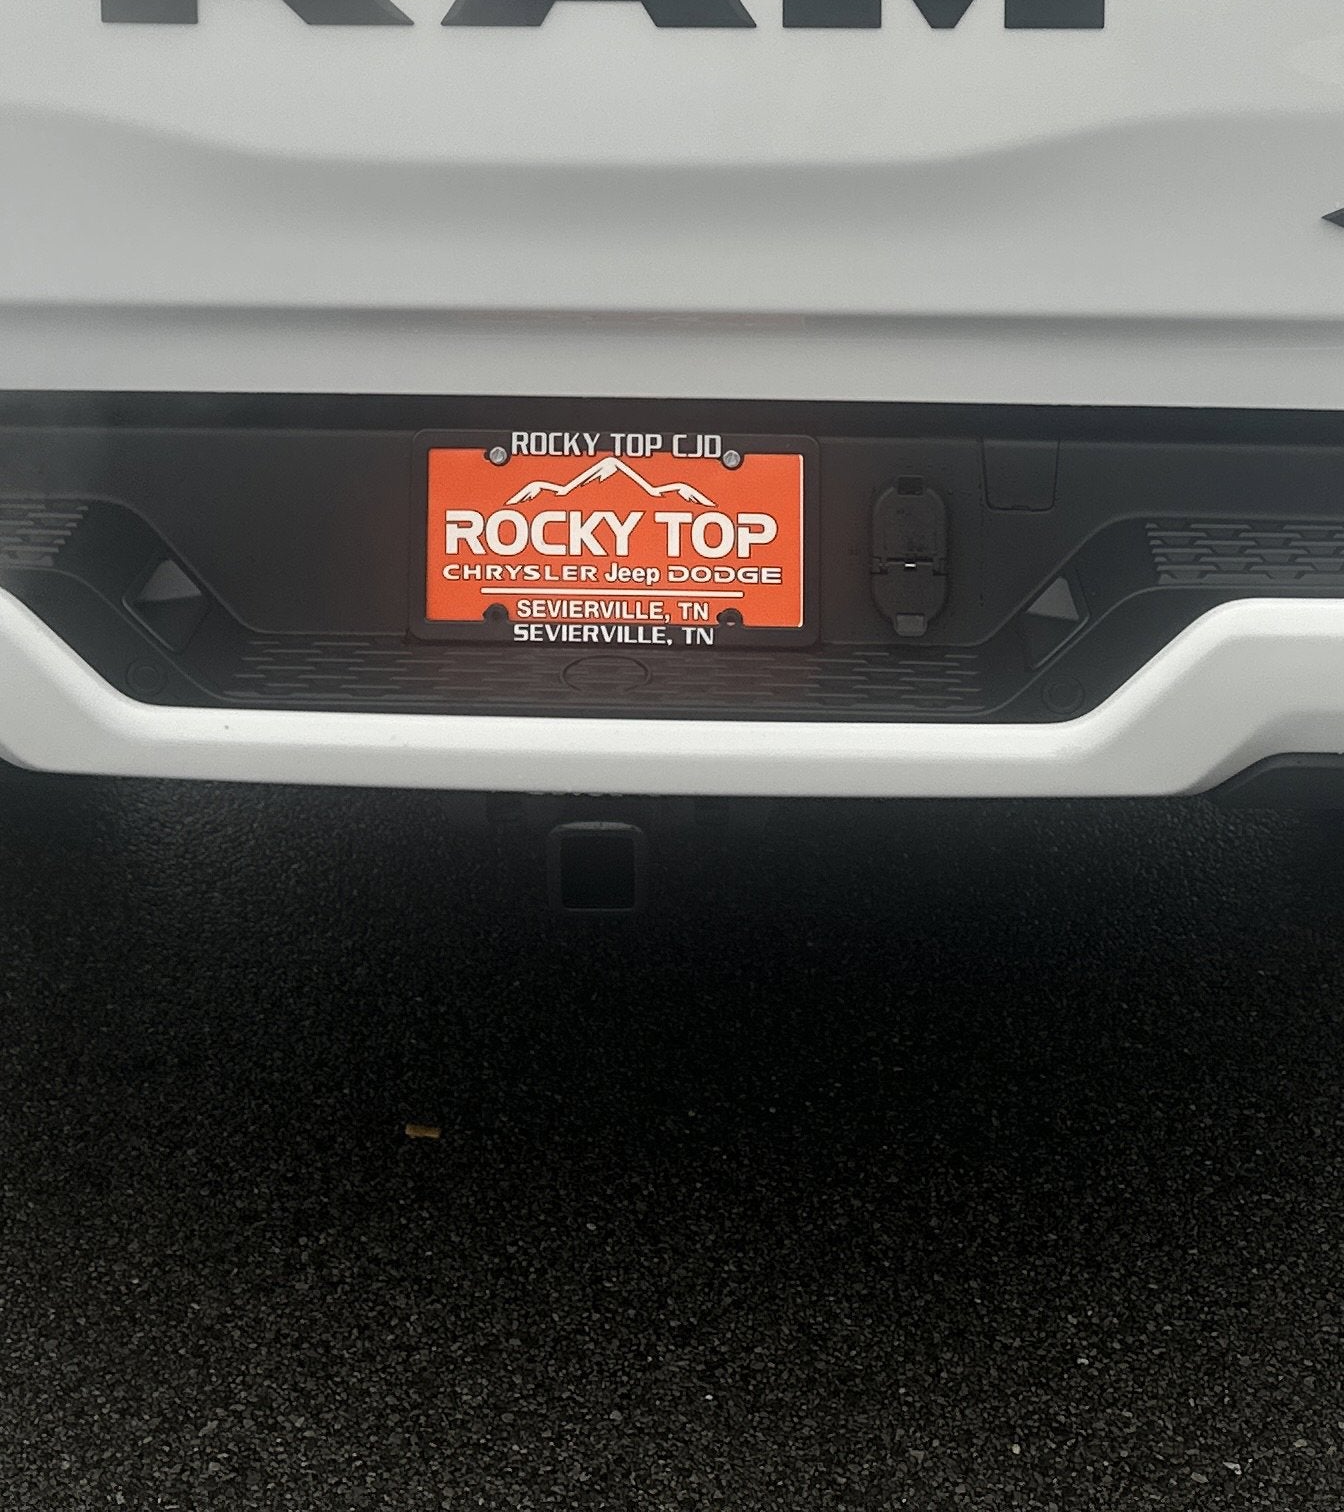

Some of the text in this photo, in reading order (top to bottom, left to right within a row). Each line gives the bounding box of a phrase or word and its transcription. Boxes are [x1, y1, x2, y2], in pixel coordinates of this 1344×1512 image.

[510, 431, 722, 459] ROCKY TOP CJD
[445, 508, 779, 560] ROCKY TOP
[442, 562, 783, 586] CHRYSLER Jeep DODGE
[516, 599, 710, 623] SEVIERVILLE, TN
[513, 623, 715, 647] SEVIERVILLE, TN
